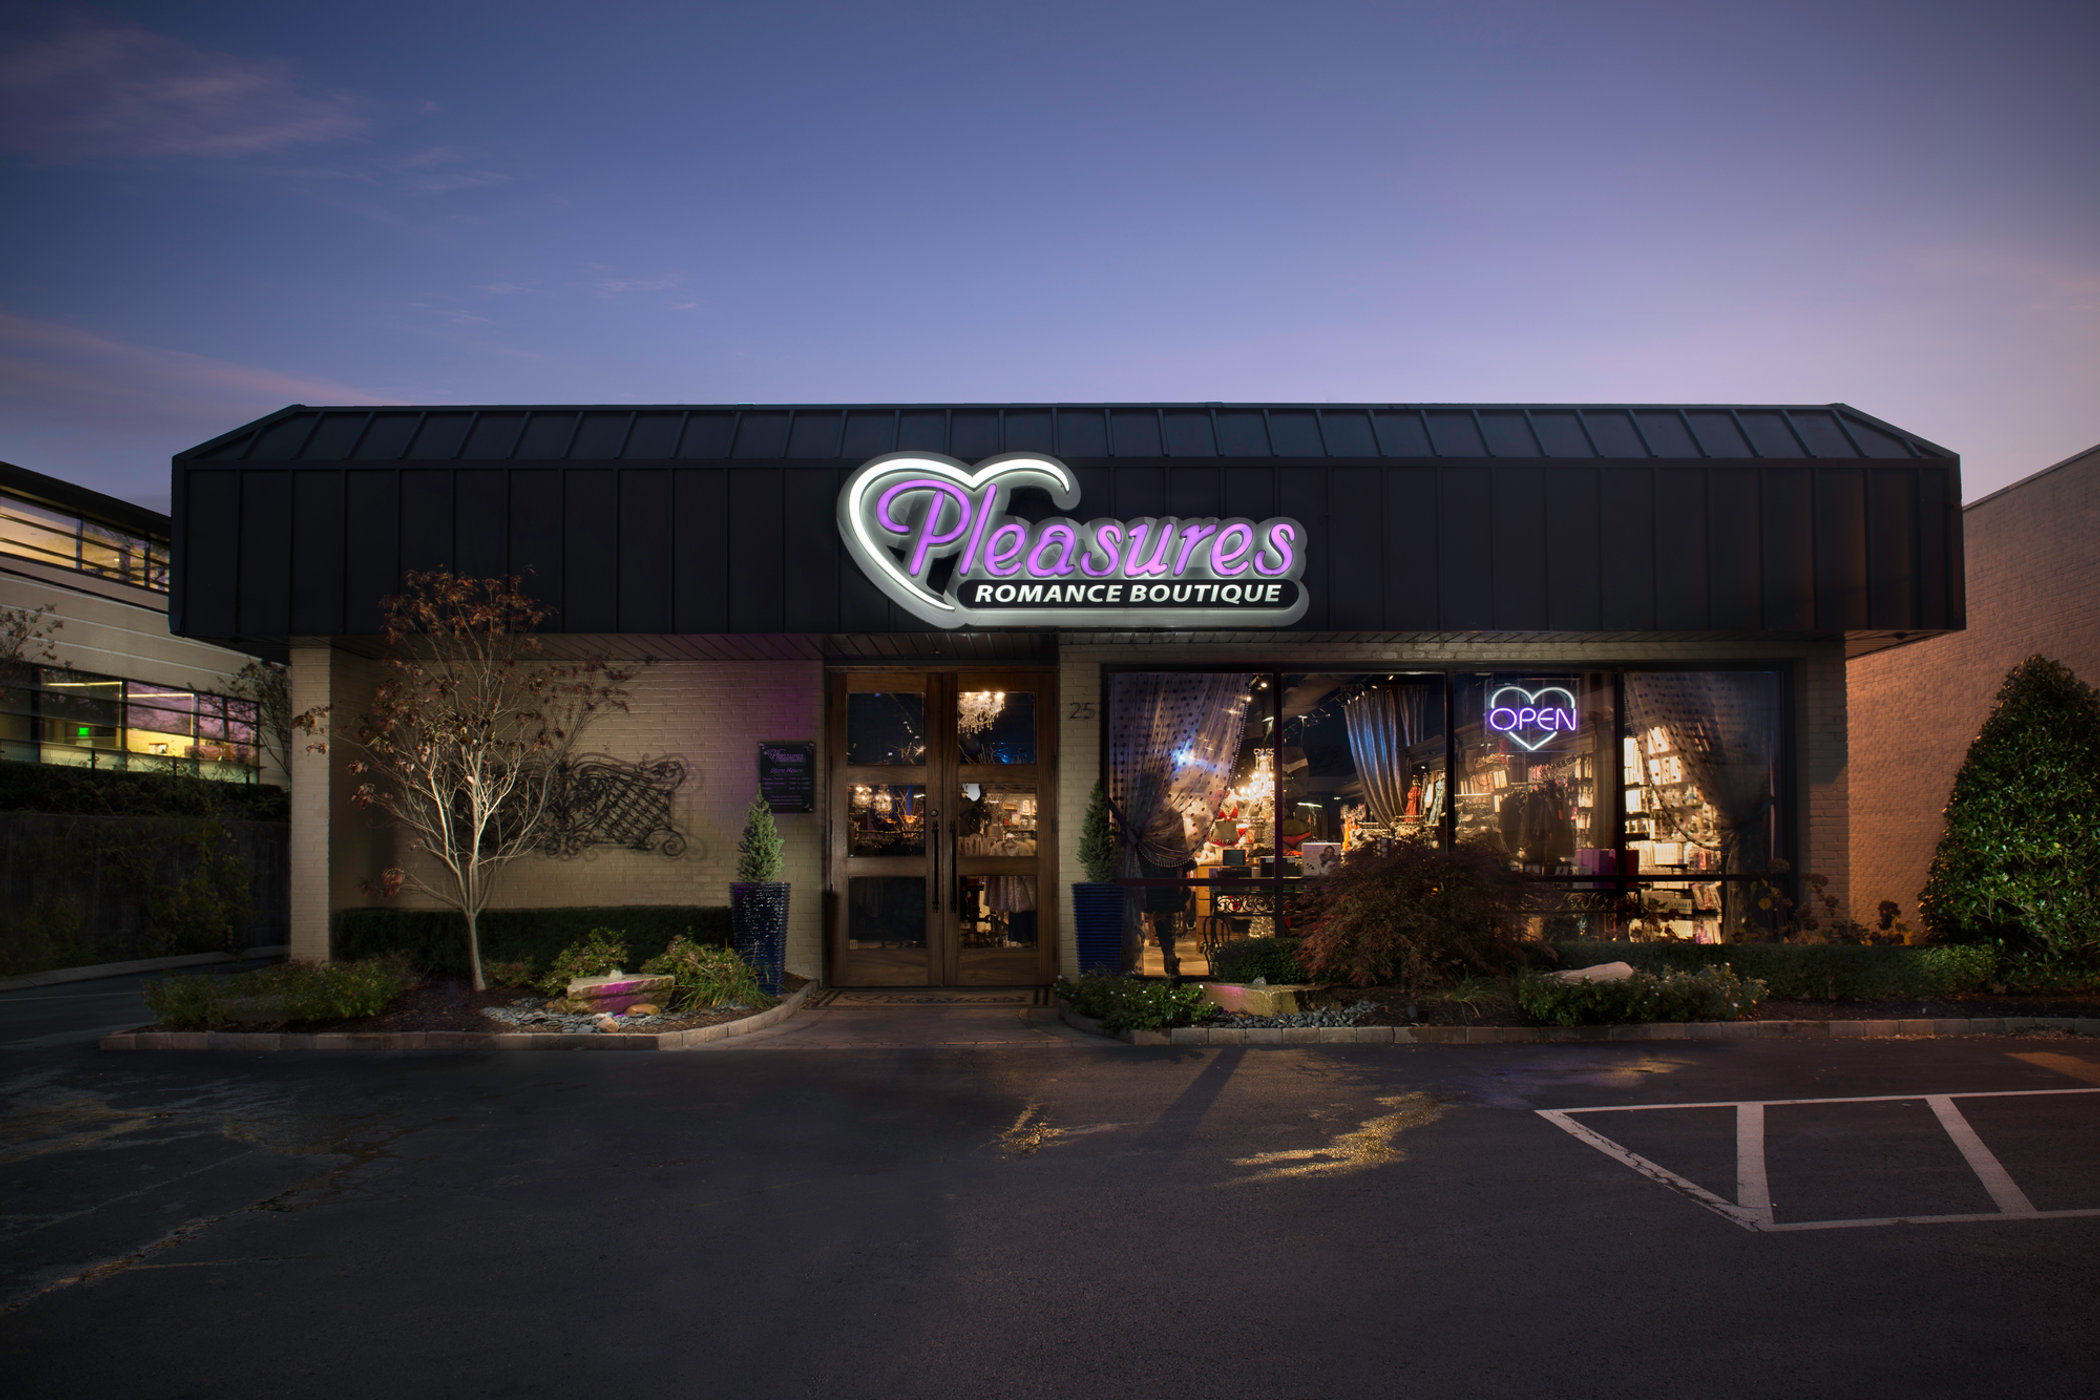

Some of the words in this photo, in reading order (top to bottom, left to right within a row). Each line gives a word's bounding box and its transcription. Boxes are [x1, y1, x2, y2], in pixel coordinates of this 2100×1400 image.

[876, 478, 1296, 578] Pleasures
[974, 584, 1121, 603] ROMANCE
[1129, 584, 1282, 605] BOUTIQUE
[1068, 702, 1096, 719] 25
[1490, 707, 1576, 731] OPEN
